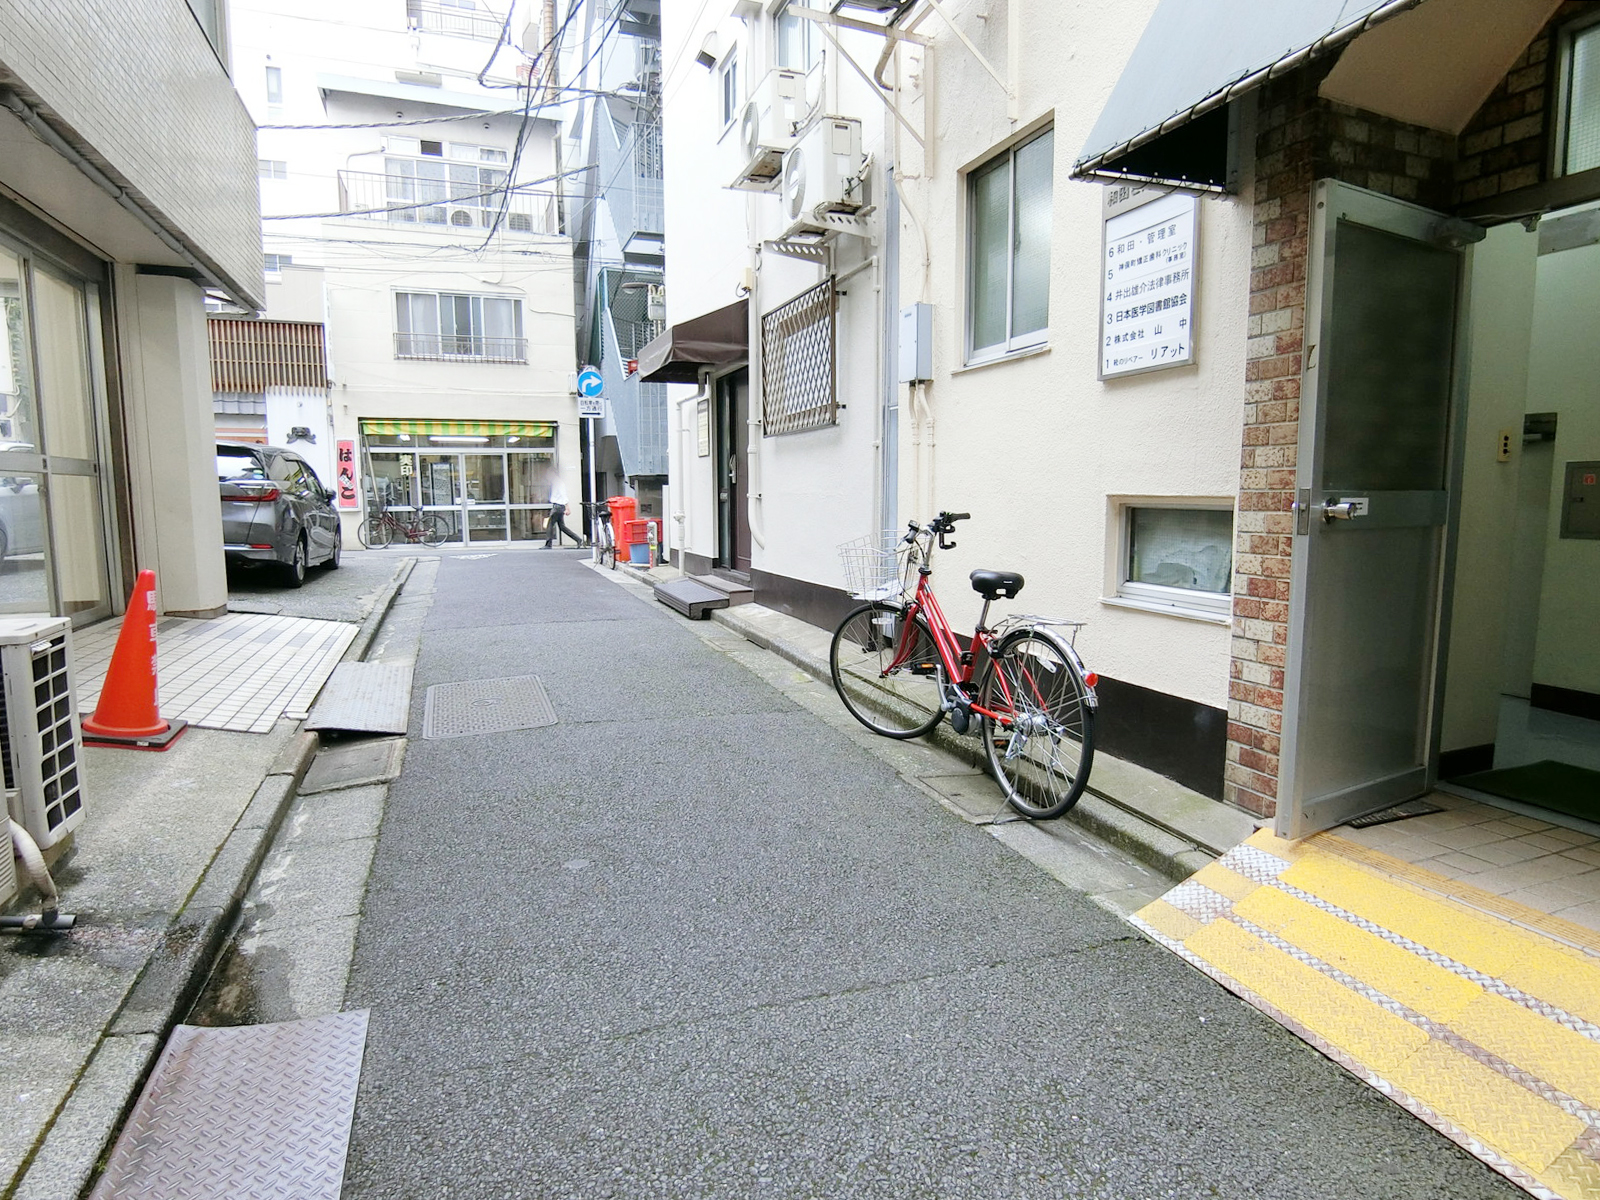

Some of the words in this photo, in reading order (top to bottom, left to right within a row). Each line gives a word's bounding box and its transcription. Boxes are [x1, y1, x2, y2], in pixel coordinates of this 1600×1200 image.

[1108, 247, 1114, 258] 6
[1117, 224, 1176, 254] 和田・管理室
[1106, 292, 1112, 302] 4
[1115, 268, 1190, 301] 井出雄介法律事務所
[1107, 269, 1113, 280] 5
[1106, 313, 1113, 324] 3
[1116, 293, 1187, 322] 日本医学図書館協会
[1105, 336, 1111, 346] 2
[1114, 329, 1144, 344] 株式会社
[1105, 359, 1109, 369] 1
[1150, 343, 1185, 360] リアット
[339, 448, 356, 500] はんこ
